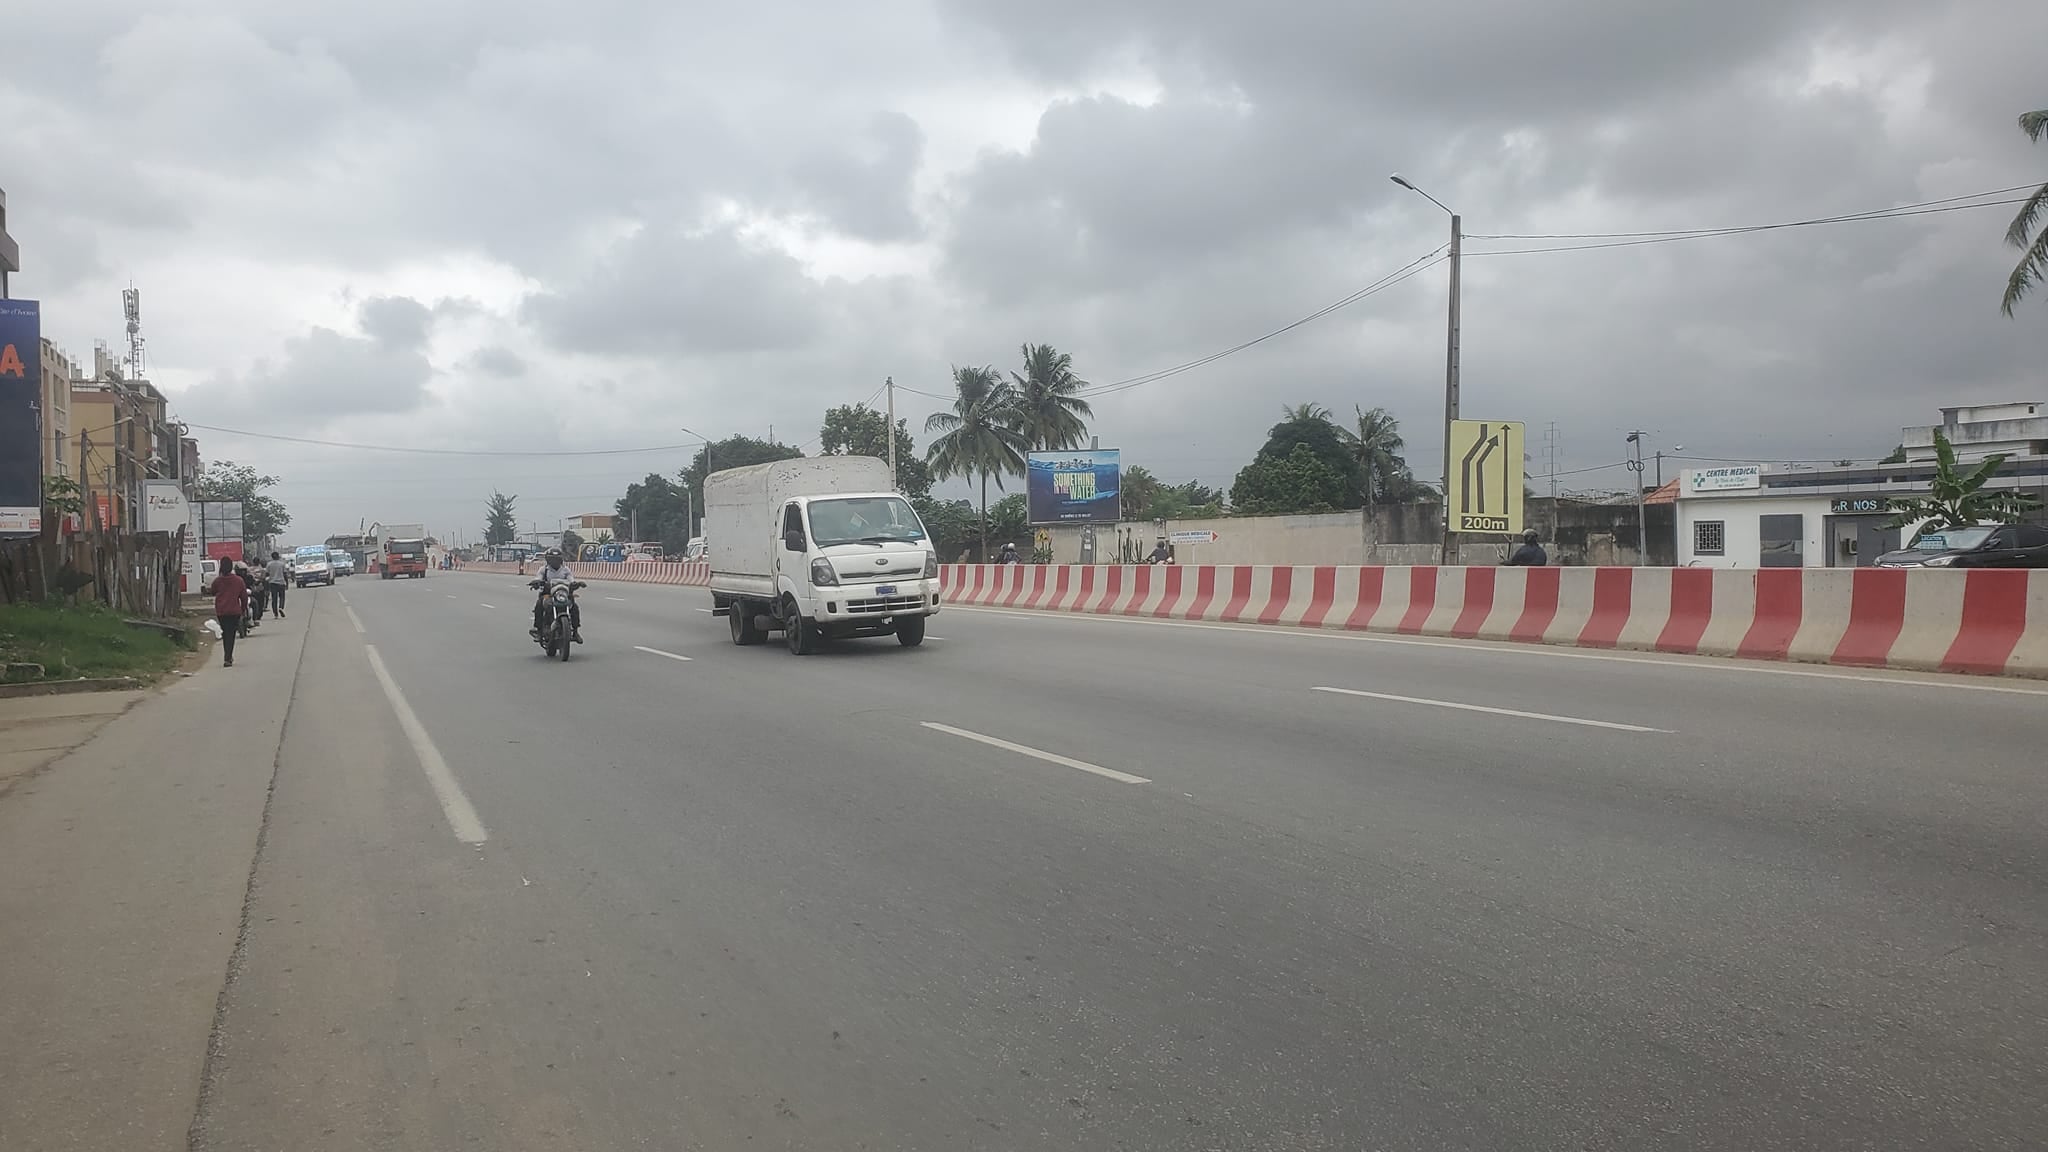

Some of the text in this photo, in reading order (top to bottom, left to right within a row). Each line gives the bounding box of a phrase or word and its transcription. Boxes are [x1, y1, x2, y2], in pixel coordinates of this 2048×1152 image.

[1706, 467, 1757, 477] CENTRE MEDICAL
[1053, 472, 1096, 486] SOMETHING
[1070, 485, 1096, 500] WATER
[1853, 499, 1877, 511] NOS
[1464, 517, 1505, 530] 200m
